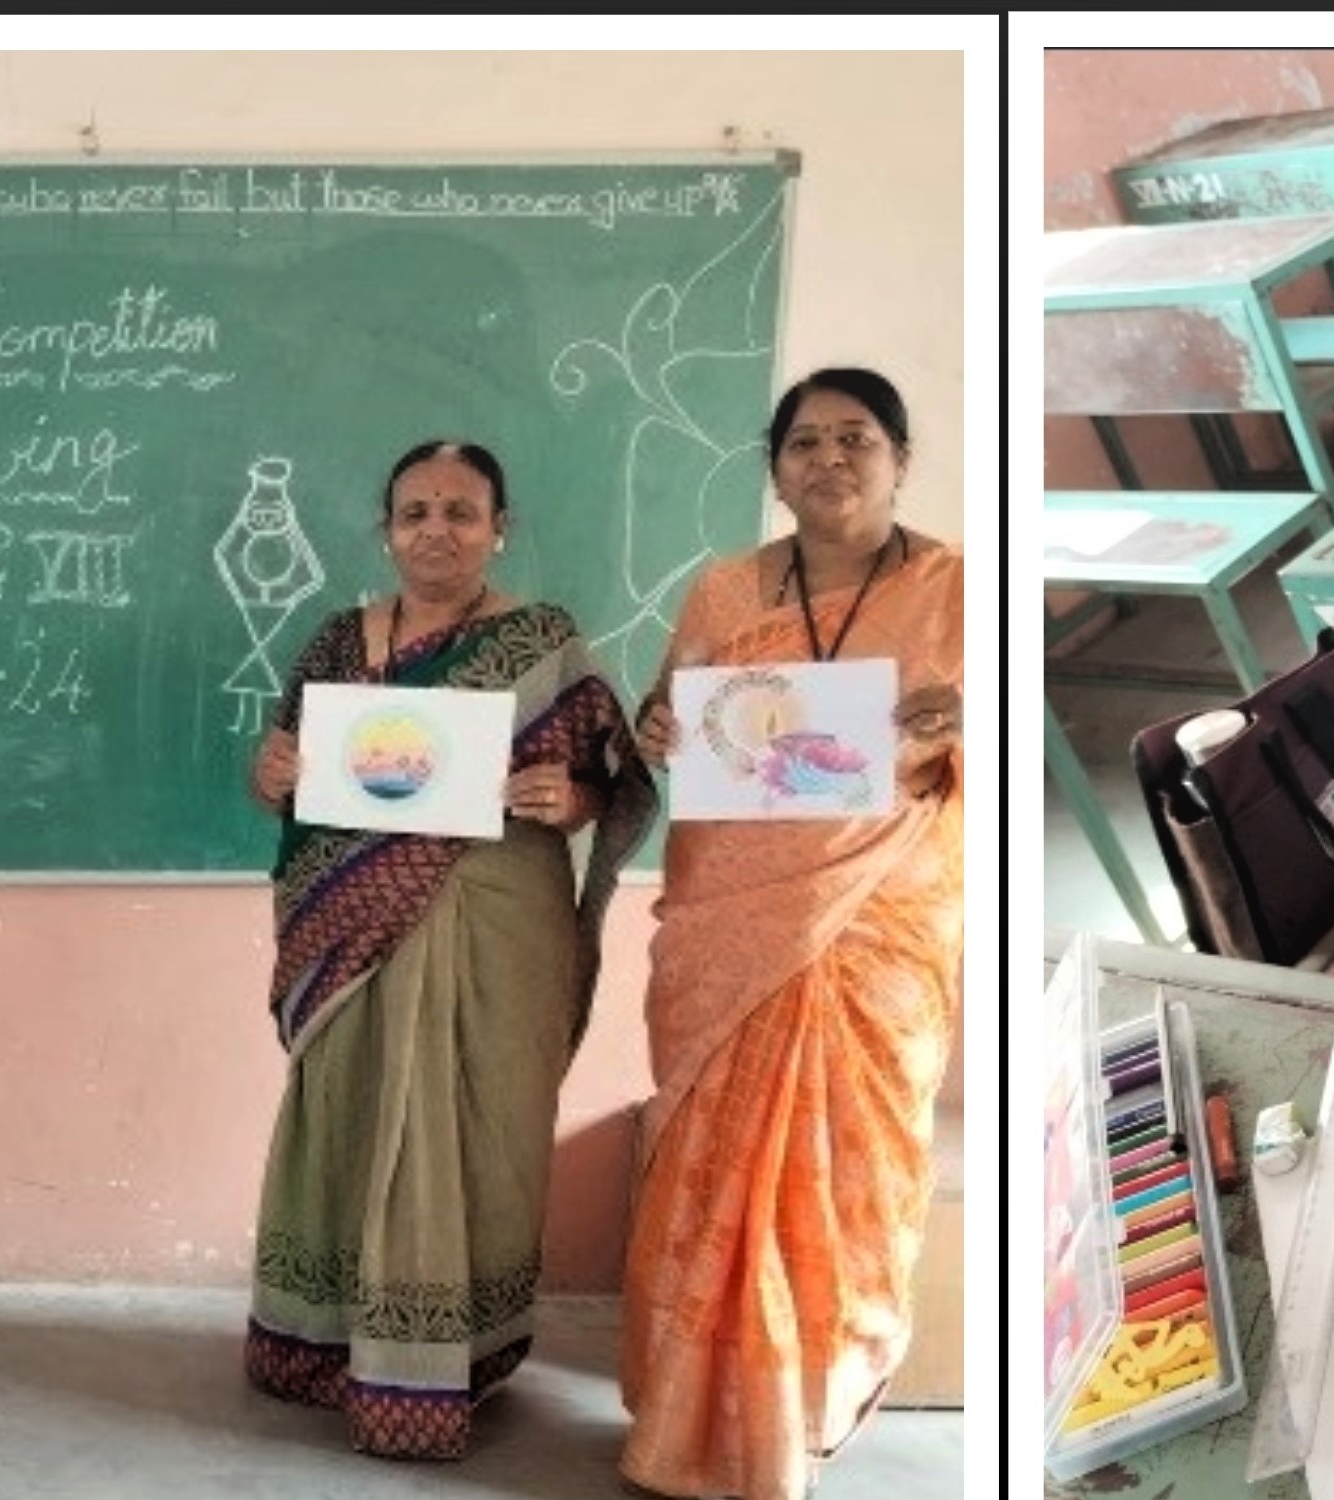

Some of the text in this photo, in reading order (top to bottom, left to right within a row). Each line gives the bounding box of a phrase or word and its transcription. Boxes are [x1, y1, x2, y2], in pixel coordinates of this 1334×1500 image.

[178, 168, 229, 211] fail
[245, 168, 305, 211] but
[589, 182, 658, 229] give
[25, 531, 136, 607] VIII
